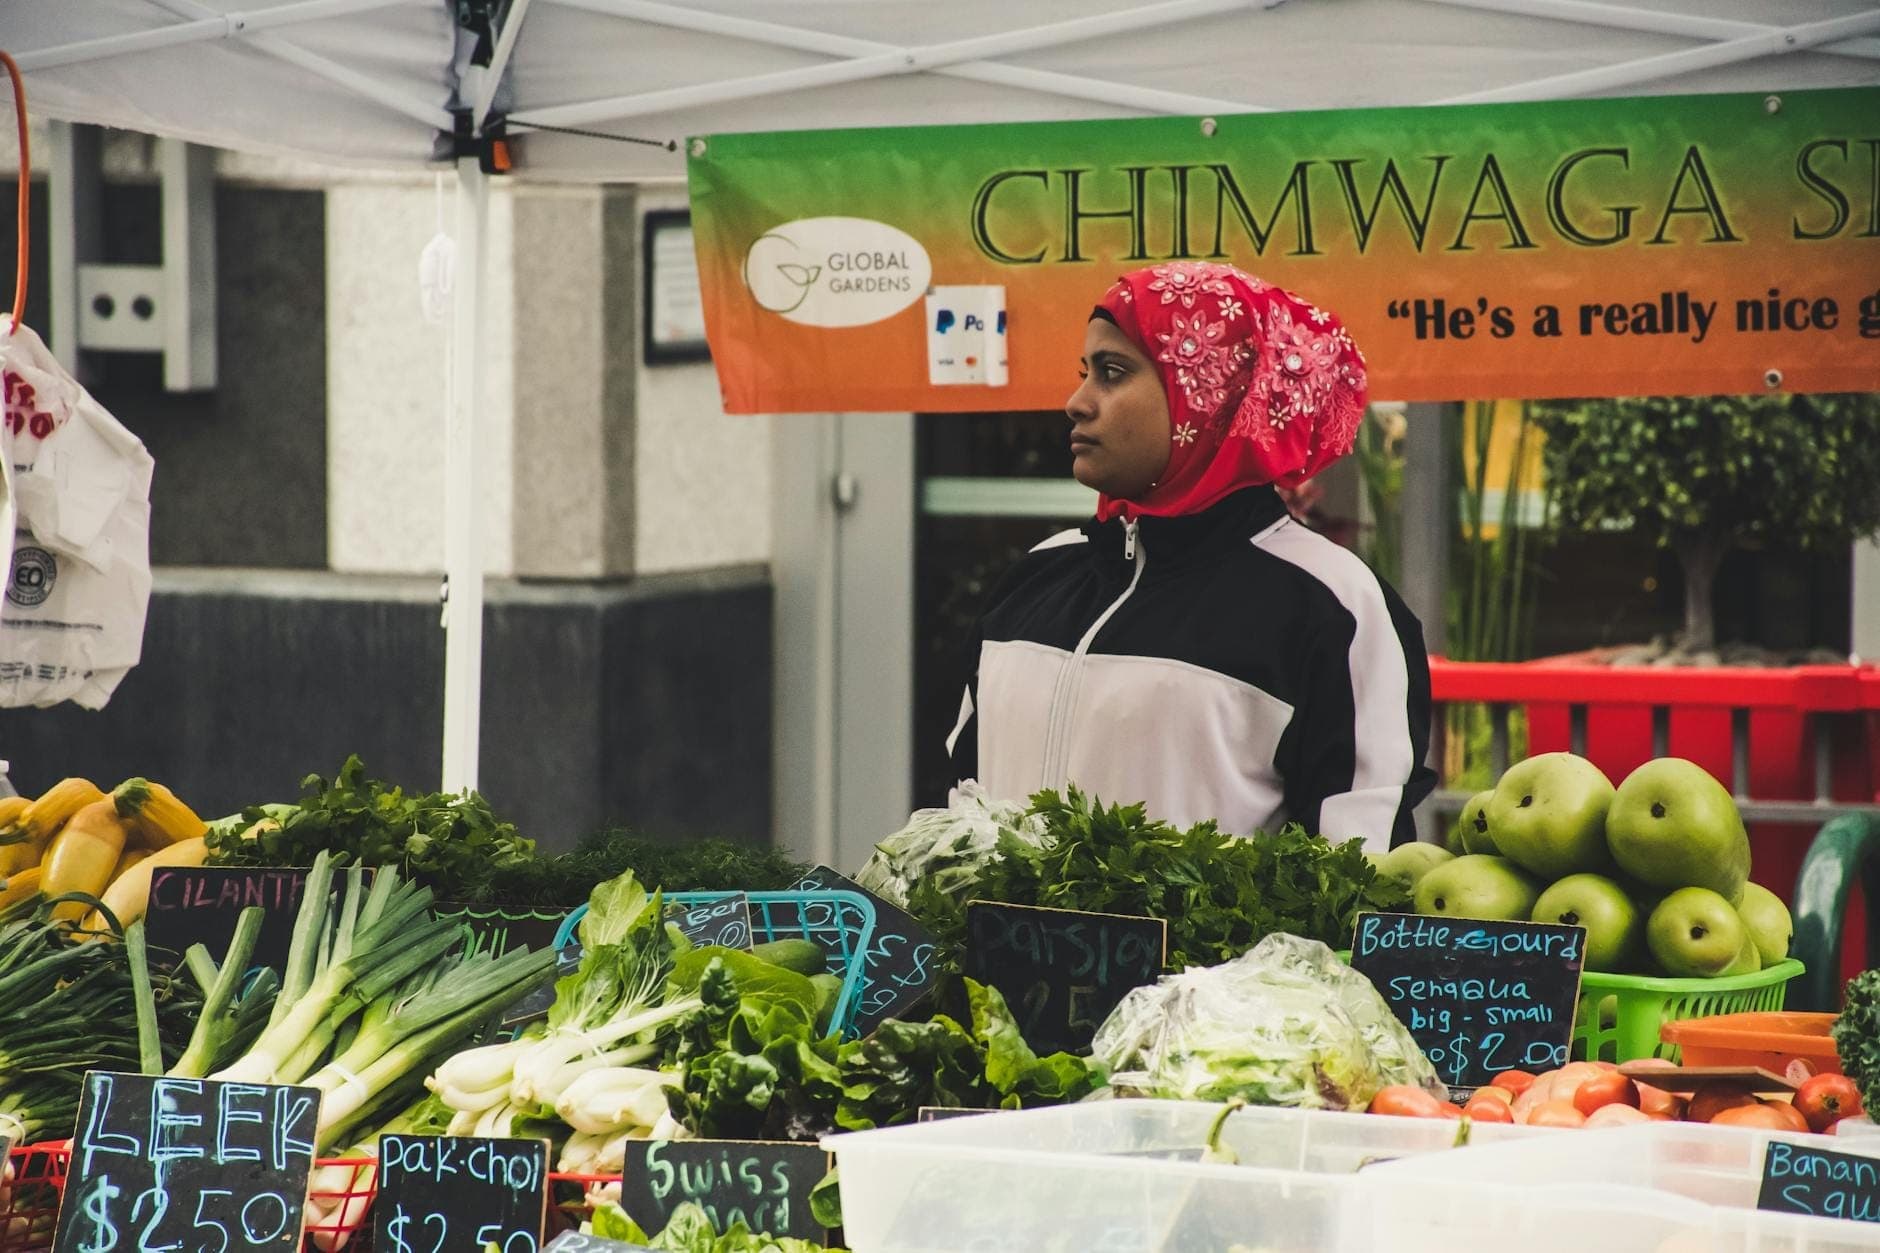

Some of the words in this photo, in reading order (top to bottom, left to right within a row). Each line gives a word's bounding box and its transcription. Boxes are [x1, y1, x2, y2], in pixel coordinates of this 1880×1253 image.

[970, 144, 1743, 264] CHIMWAGA
[828, 252, 910, 271] GLOBAL
[829, 276, 911, 293] GARDENS
[1532, 305, 1562, 337] a
[1579, 291, 1717, 343] really
[1736, 288, 1840, 332] nice
[1362, 917, 1451, 956] Bottle
[1411, 1007, 1452, 1033] big
[82, 1075, 314, 1180] LEEK
[646, 1140, 790, 1199] Swiss
[1769, 1143, 1880, 1187] Banan
[1782, 1183, 1880, 1221] Squ
